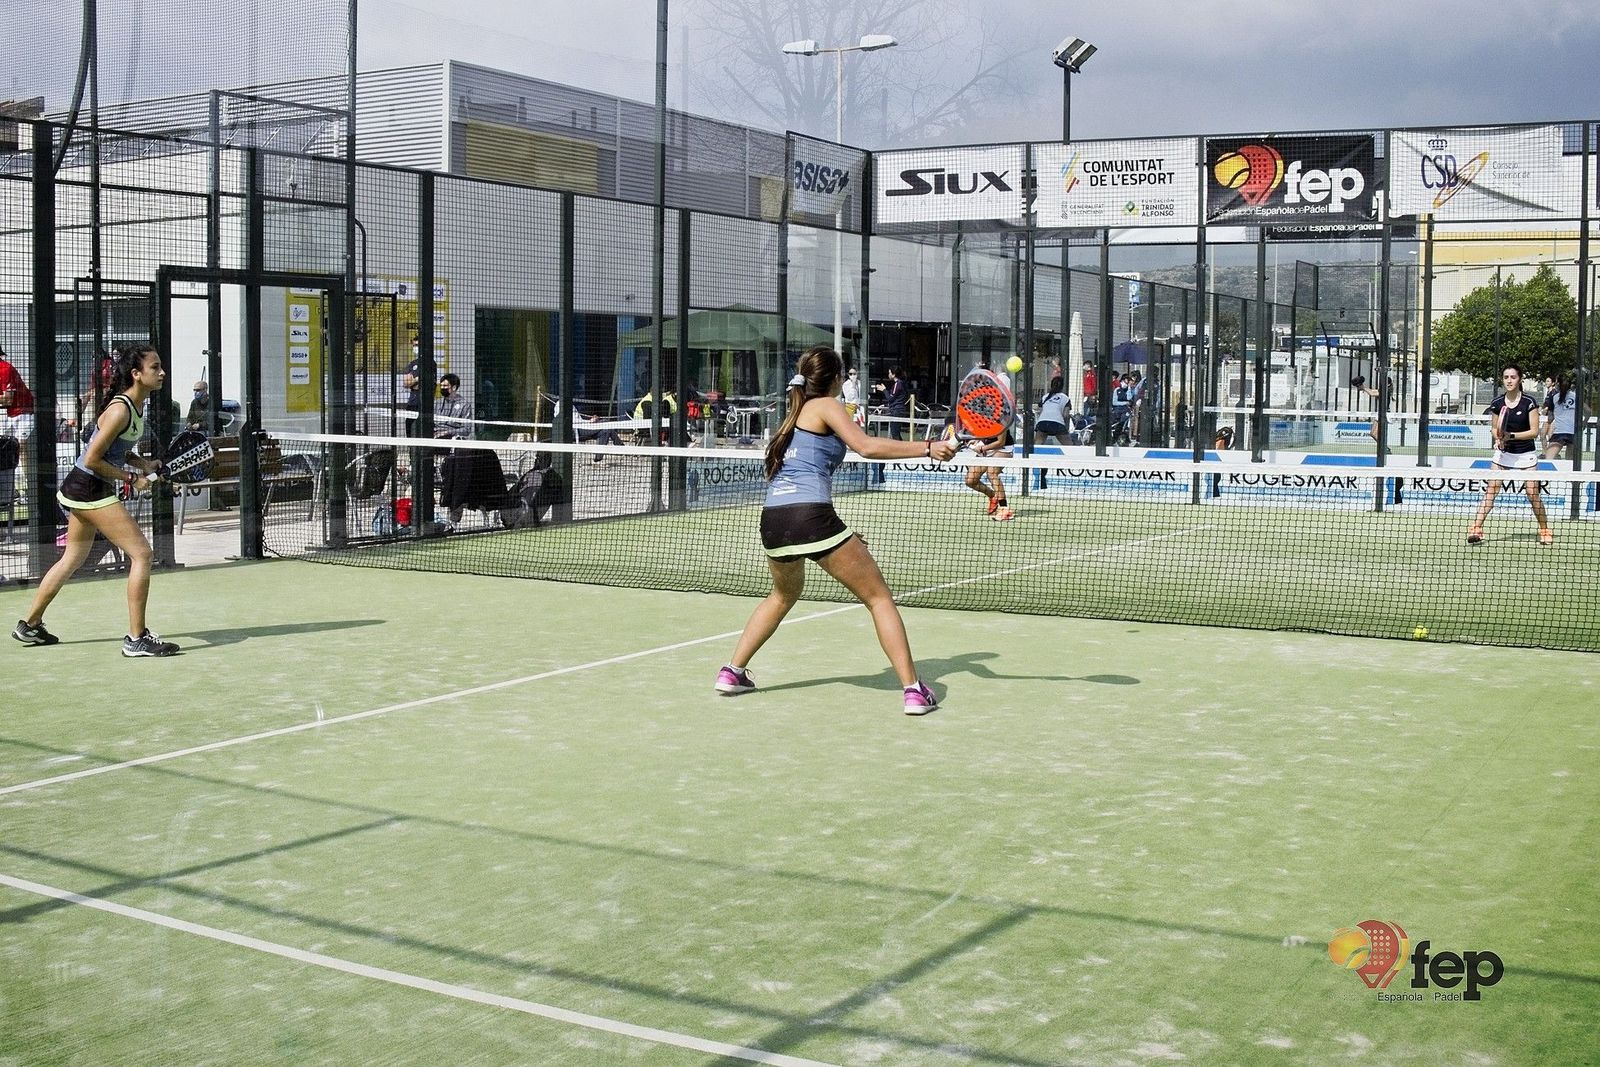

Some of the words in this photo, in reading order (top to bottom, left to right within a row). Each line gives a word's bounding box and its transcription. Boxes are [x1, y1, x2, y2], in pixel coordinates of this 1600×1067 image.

[1083, 158, 1164, 174] COMUNITAT
[1421, 154, 1457, 189] CSD
[1089, 174, 1107, 187] DE
[1111, 172, 1175, 186] L'ESPORT
[1284, 160, 1365, 213] fep
[1141, 203, 1175, 211] TRINIDAD
[1141, 210, 1175, 218] ALFONSO
[704, 464, 766, 485] ROGESMA
[1229, 473, 1358, 489] ROGESMAR
